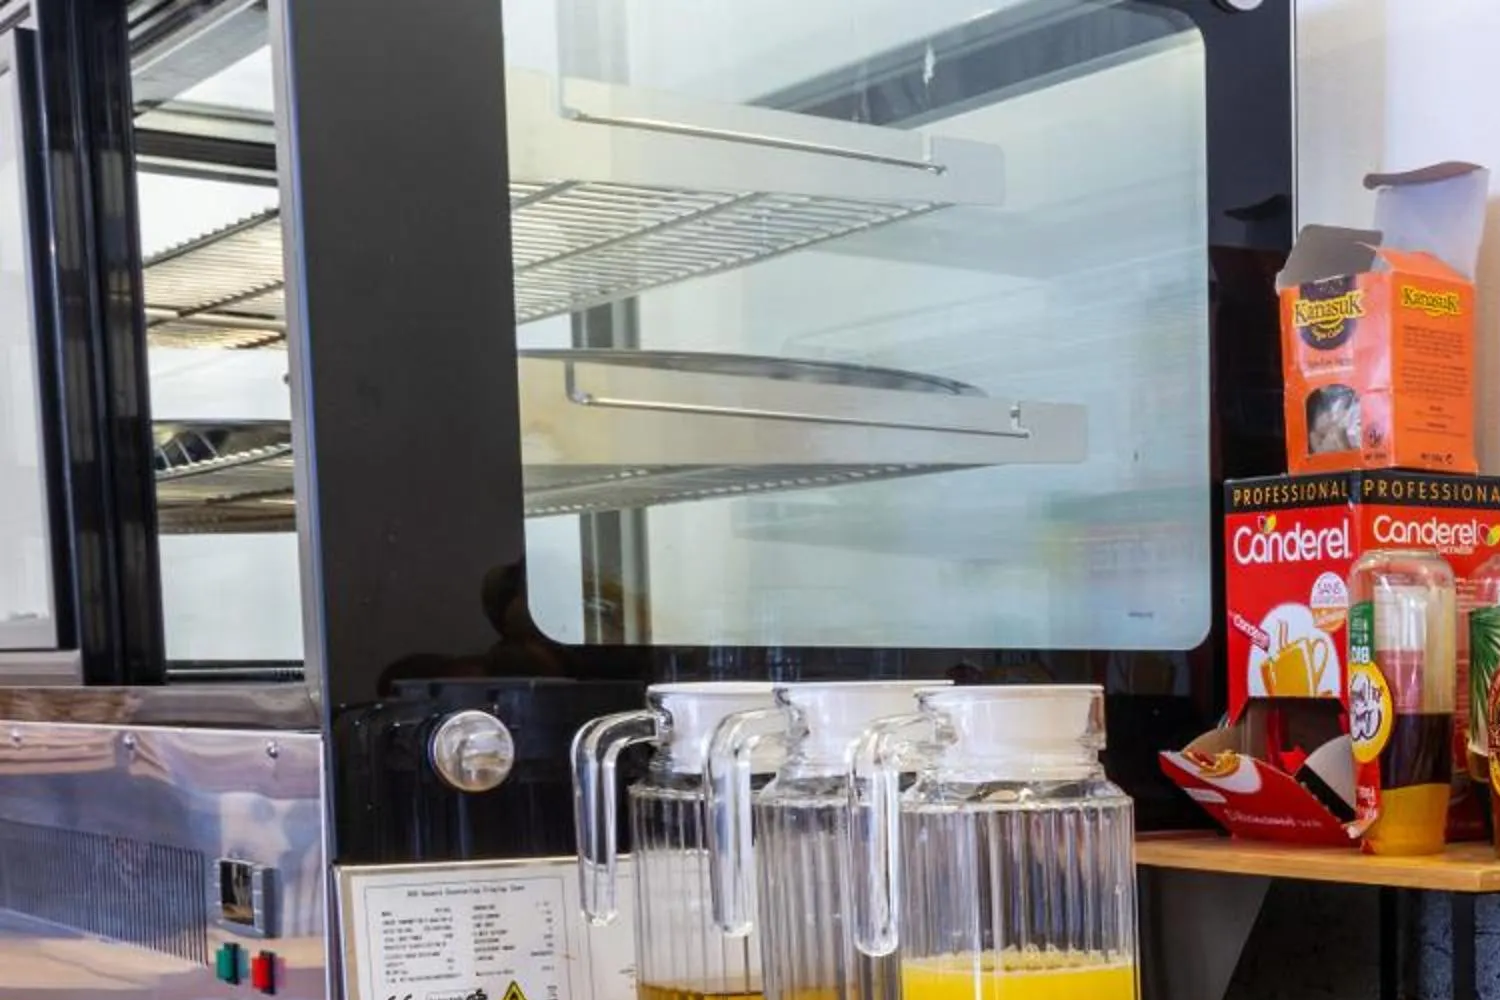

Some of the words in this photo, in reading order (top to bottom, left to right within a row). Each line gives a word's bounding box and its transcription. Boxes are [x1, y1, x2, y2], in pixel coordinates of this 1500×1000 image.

[1233, 480, 1348, 506] PROFESSIONAL
[1233, 518, 1350, 564] Canderel
[1373, 514, 1478, 545] Canderel
